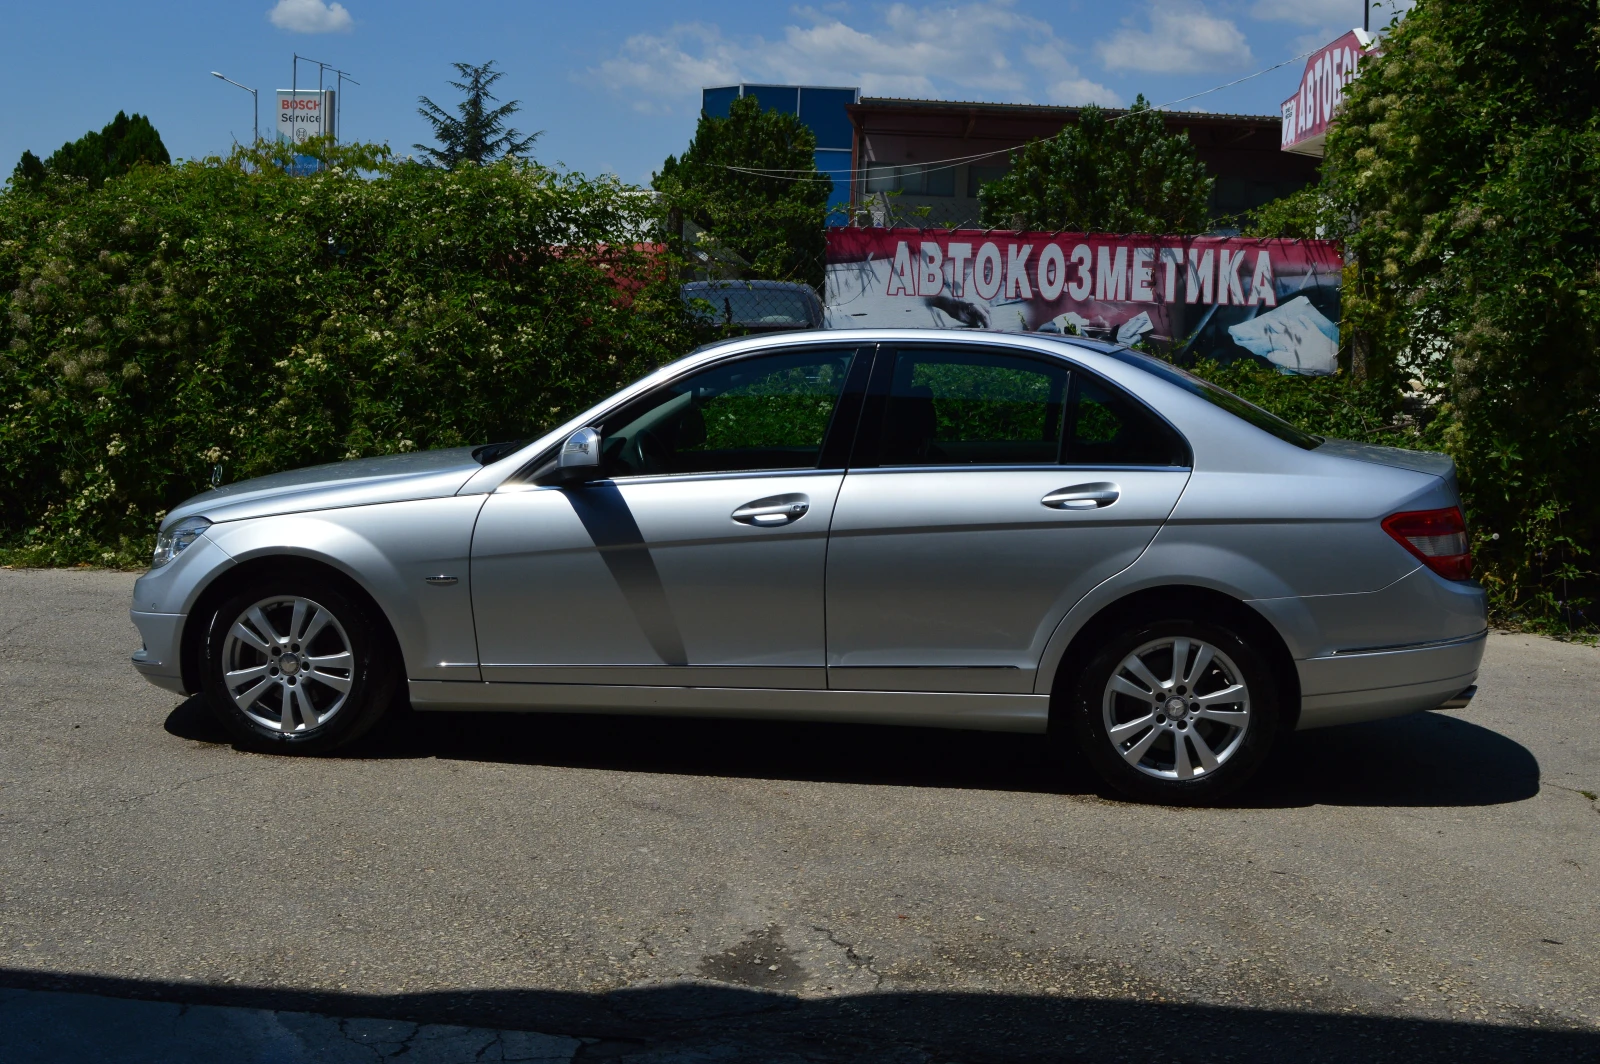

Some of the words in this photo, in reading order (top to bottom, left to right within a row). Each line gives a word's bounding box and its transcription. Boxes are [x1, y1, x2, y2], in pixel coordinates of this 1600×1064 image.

[281, 99, 321, 110] BOSCH
[281, 113, 321, 123] Service
[887, 241, 1277, 306] АВТОКОЗМЕТИКА
